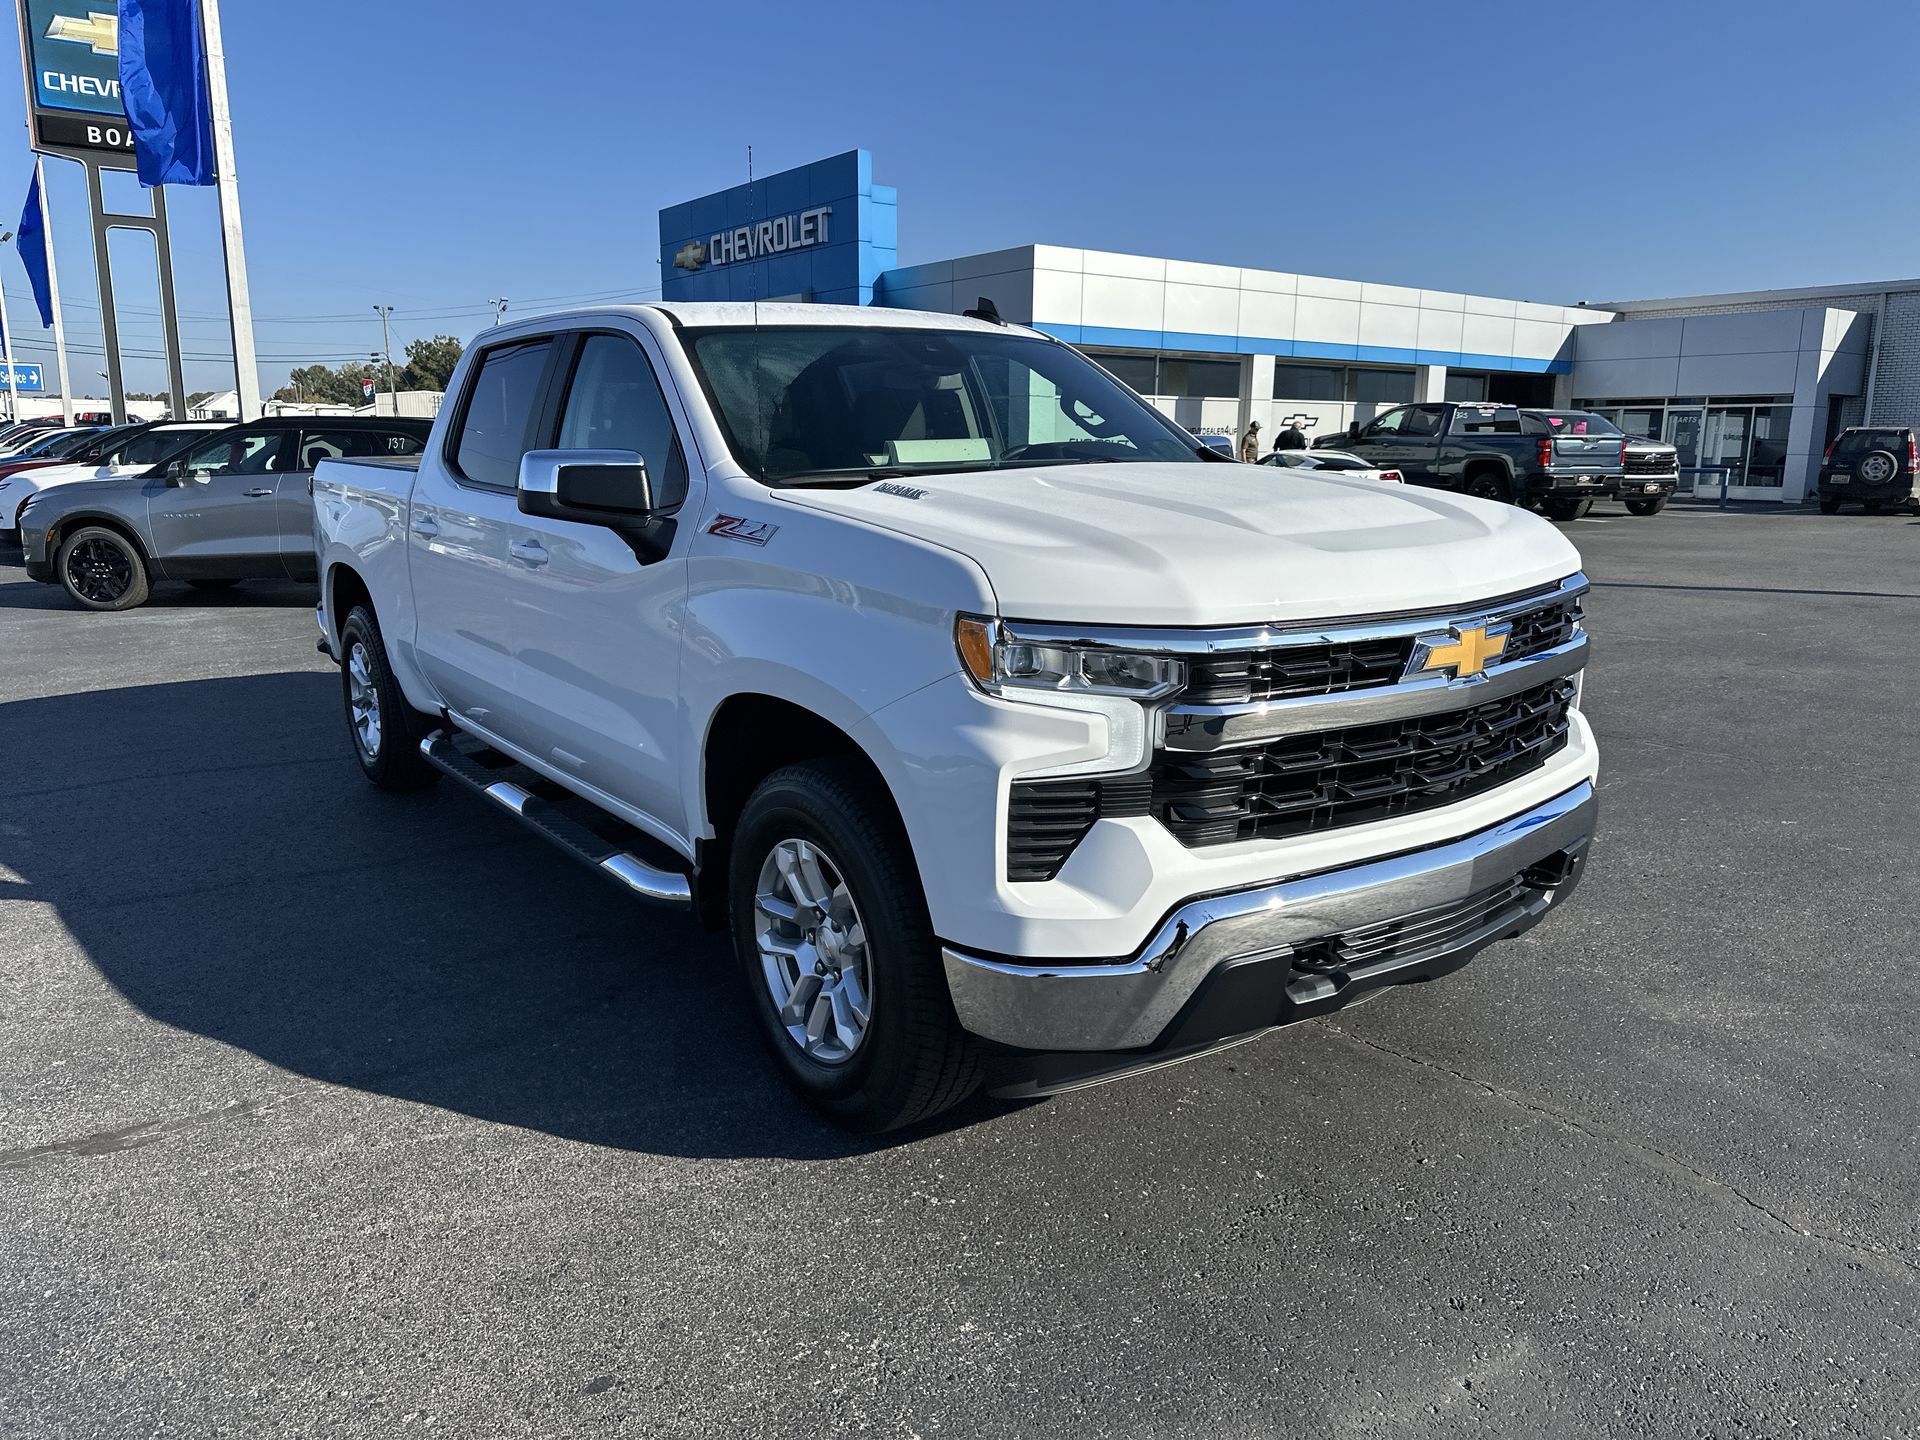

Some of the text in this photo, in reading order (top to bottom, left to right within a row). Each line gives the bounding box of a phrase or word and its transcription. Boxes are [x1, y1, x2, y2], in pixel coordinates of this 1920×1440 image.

[710, 206, 833, 266] CHEVROLET
[0, 371, 27, 384] Seice
[388, 437, 405, 449] 137
[872, 482, 930, 500] DURAMAX
[706, 512, 781, 548] Z71
